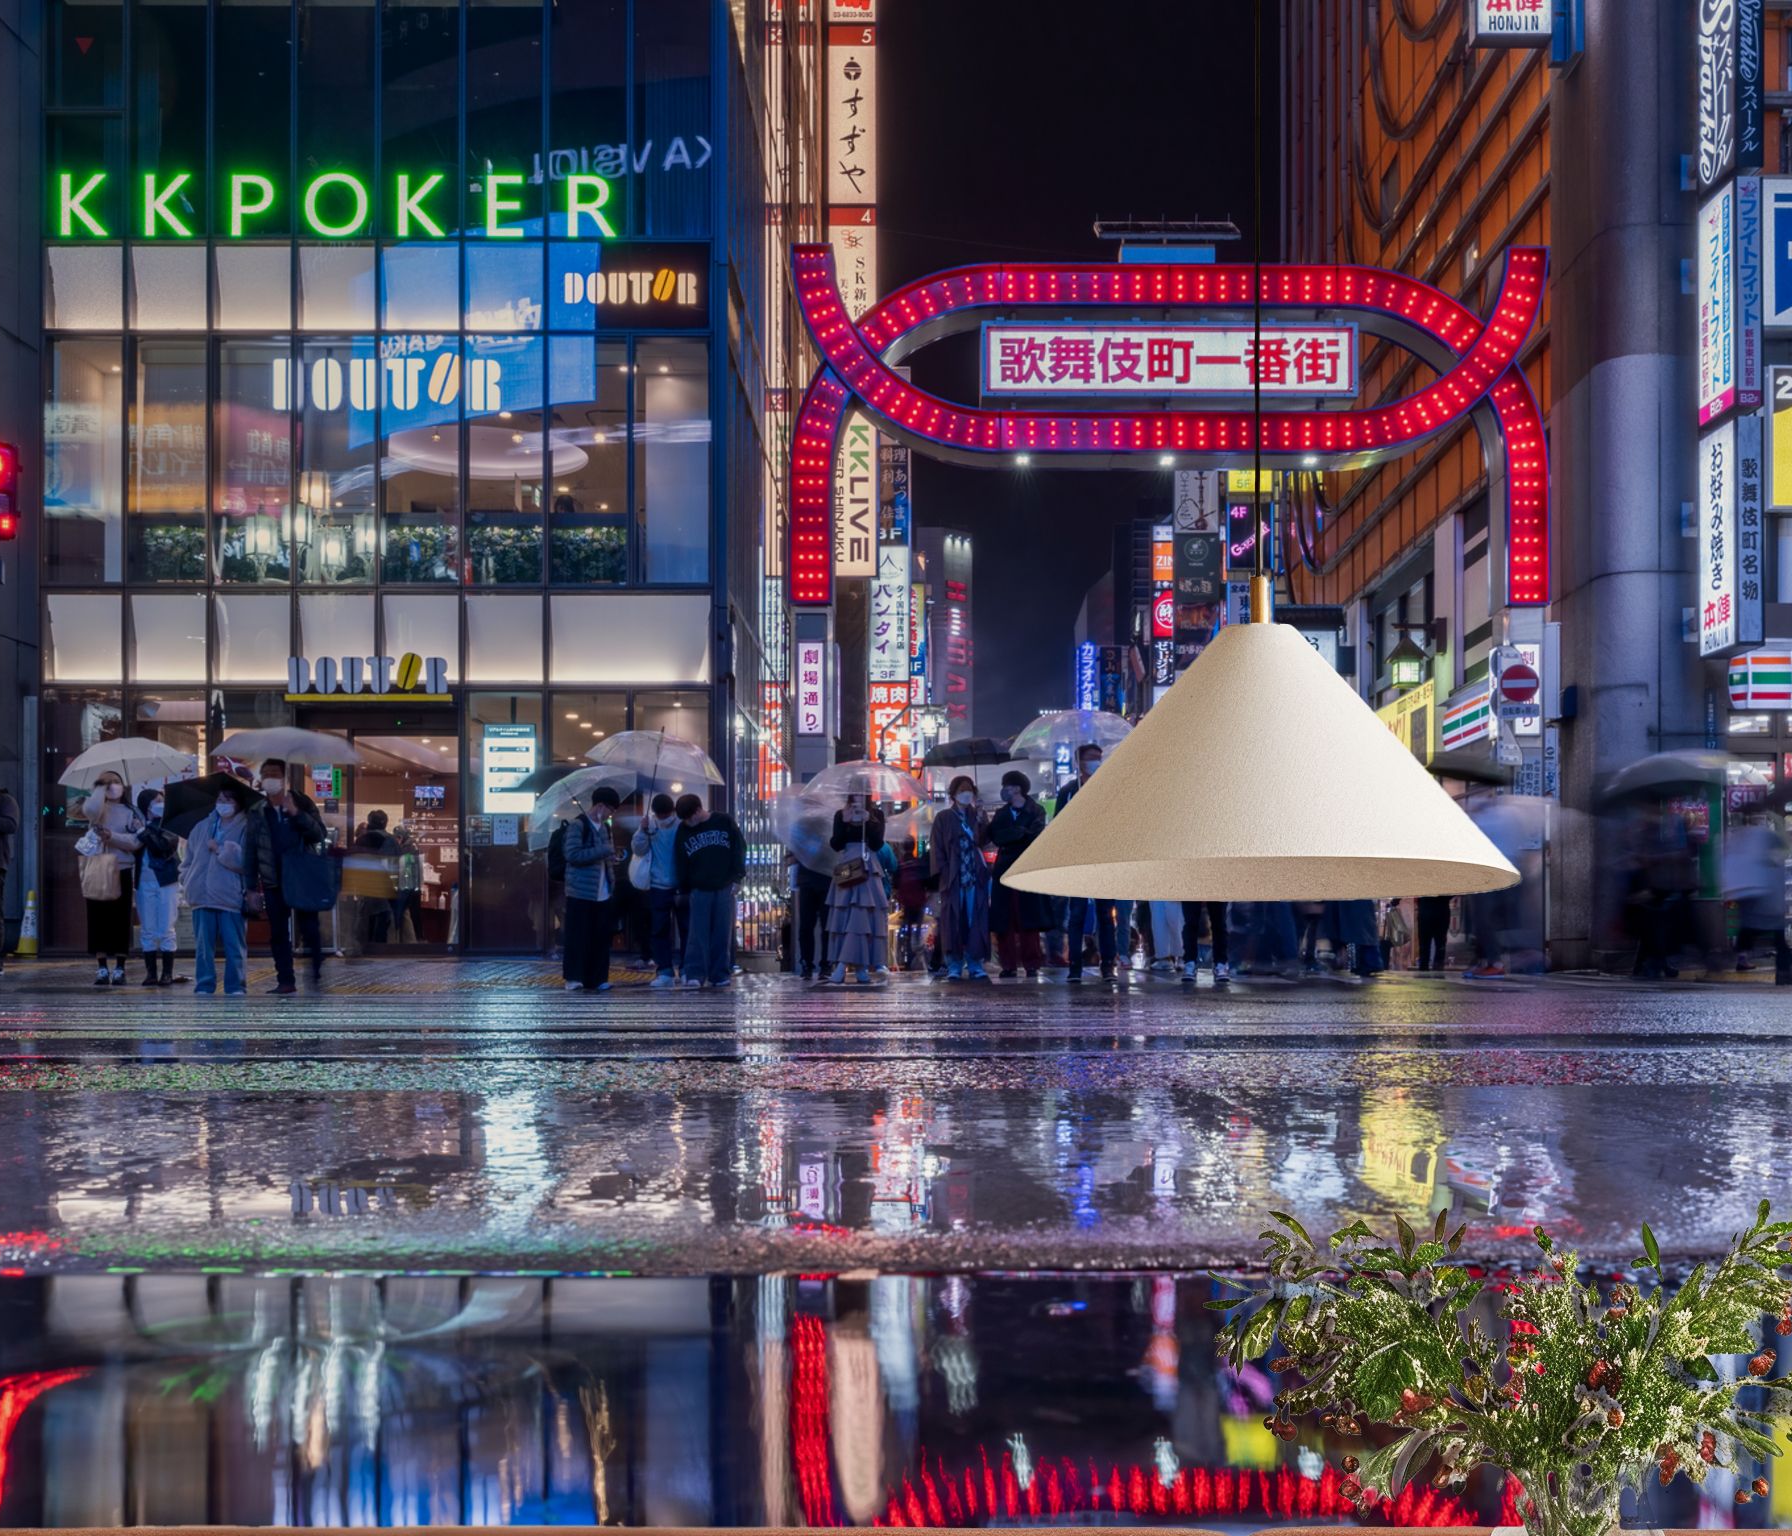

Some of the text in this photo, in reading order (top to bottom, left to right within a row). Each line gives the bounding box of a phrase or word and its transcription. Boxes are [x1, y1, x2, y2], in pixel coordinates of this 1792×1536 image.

[861, 29, 873, 43] 5
[1489, 15, 1539, 31] HONJIN
[839, 88, 866, 193] すずや
[1740, 85, 1760, 153] スパークル
[861, 209, 873, 223] 4
[563, 268, 697, 304] DOUTOR
[1740, 200, 1758, 327] ファイトフィット
[1710, 233, 1720, 394] ファイトフィット
[272, 353, 501, 411] DOUTOR
[999, 337, 1340, 386] 歌舞伎町一番街
[849, 425, 869, 562] KKLIVE
[1230, 506, 1248, 518] 4F
[1711, 443, 1724, 590] お好み焼き
[1741, 458, 1759, 600] 歌舞伎町名物
[872, 584, 893, 655] バンタイ
[1704, 594, 1730, 630] 本陣
[288, 652, 448, 694] DOUTOR
[803, 649, 819, 731] 劇場通り
[870, 686, 908, 704] 焼肉
[879, 670, 896, 679] 3F
